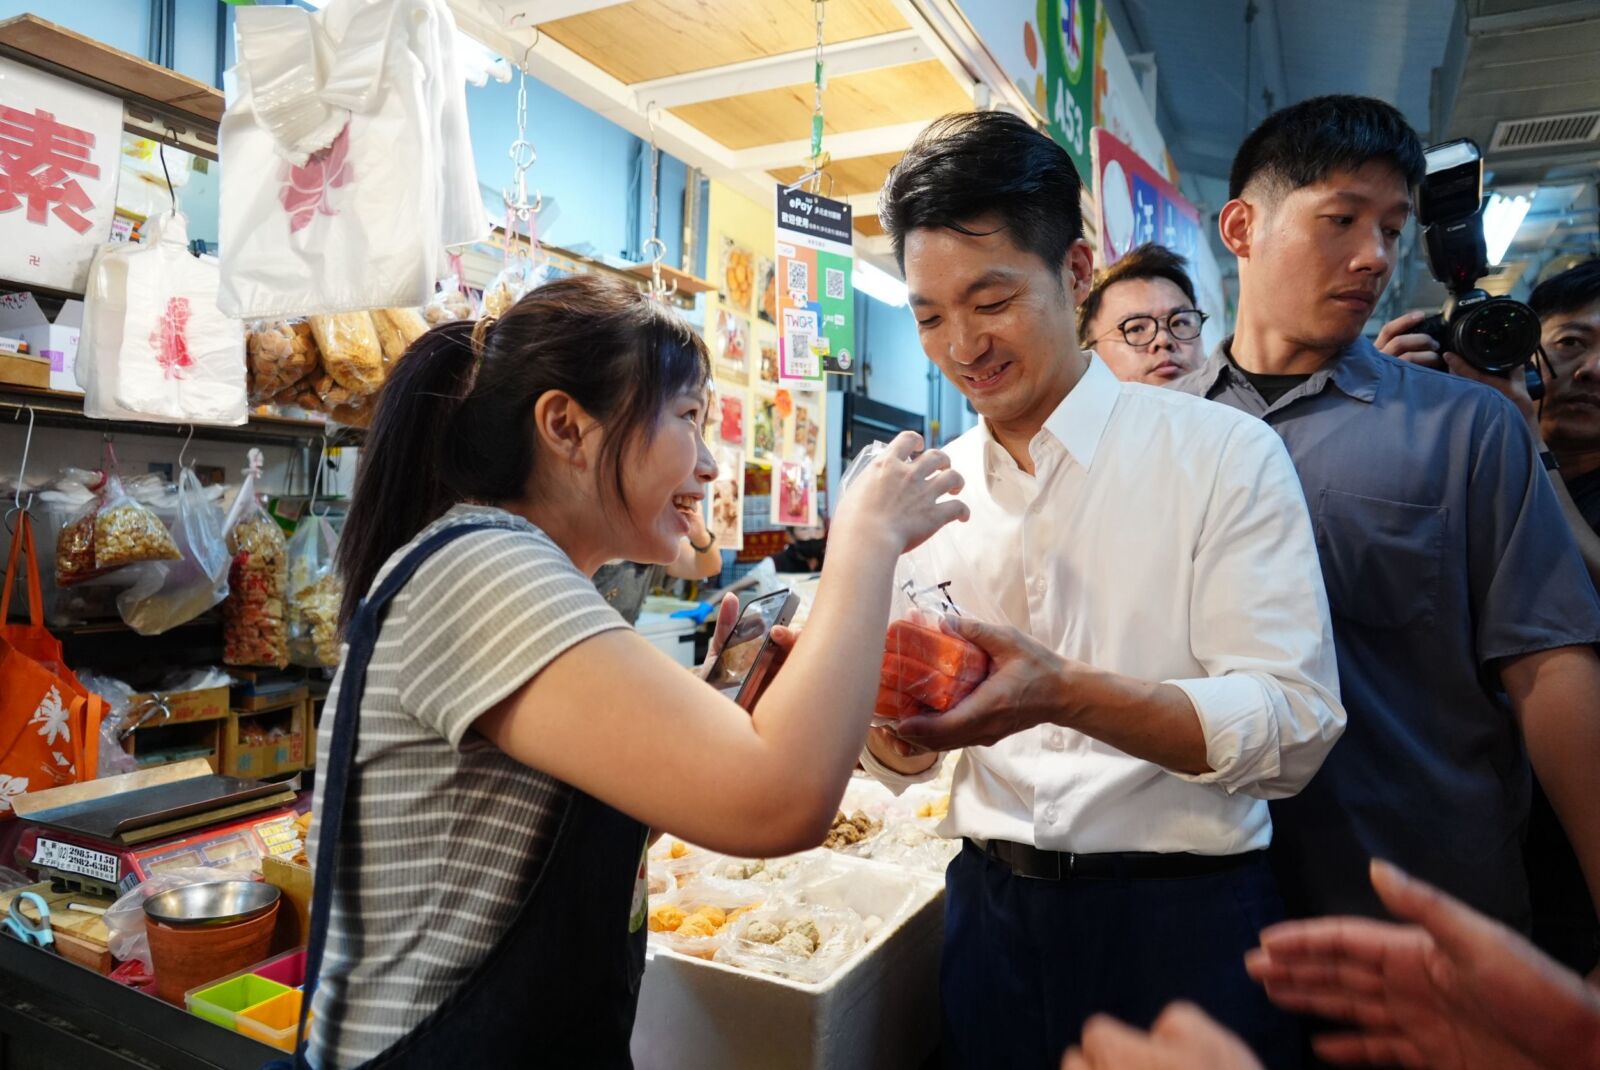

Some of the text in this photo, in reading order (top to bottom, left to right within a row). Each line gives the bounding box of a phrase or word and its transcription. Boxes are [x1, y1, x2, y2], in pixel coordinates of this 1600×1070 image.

[0, 103, 100, 236] 素
[789, 197, 813, 215] ePay
[1446, 223, 1467, 232] Canon
[1458, 295, 1487, 307] Canon
[785, 314, 814, 329] TWQR
[69, 847, 115, 865] 2985-1158
[69, 856, 114, 874] 2982-6383
